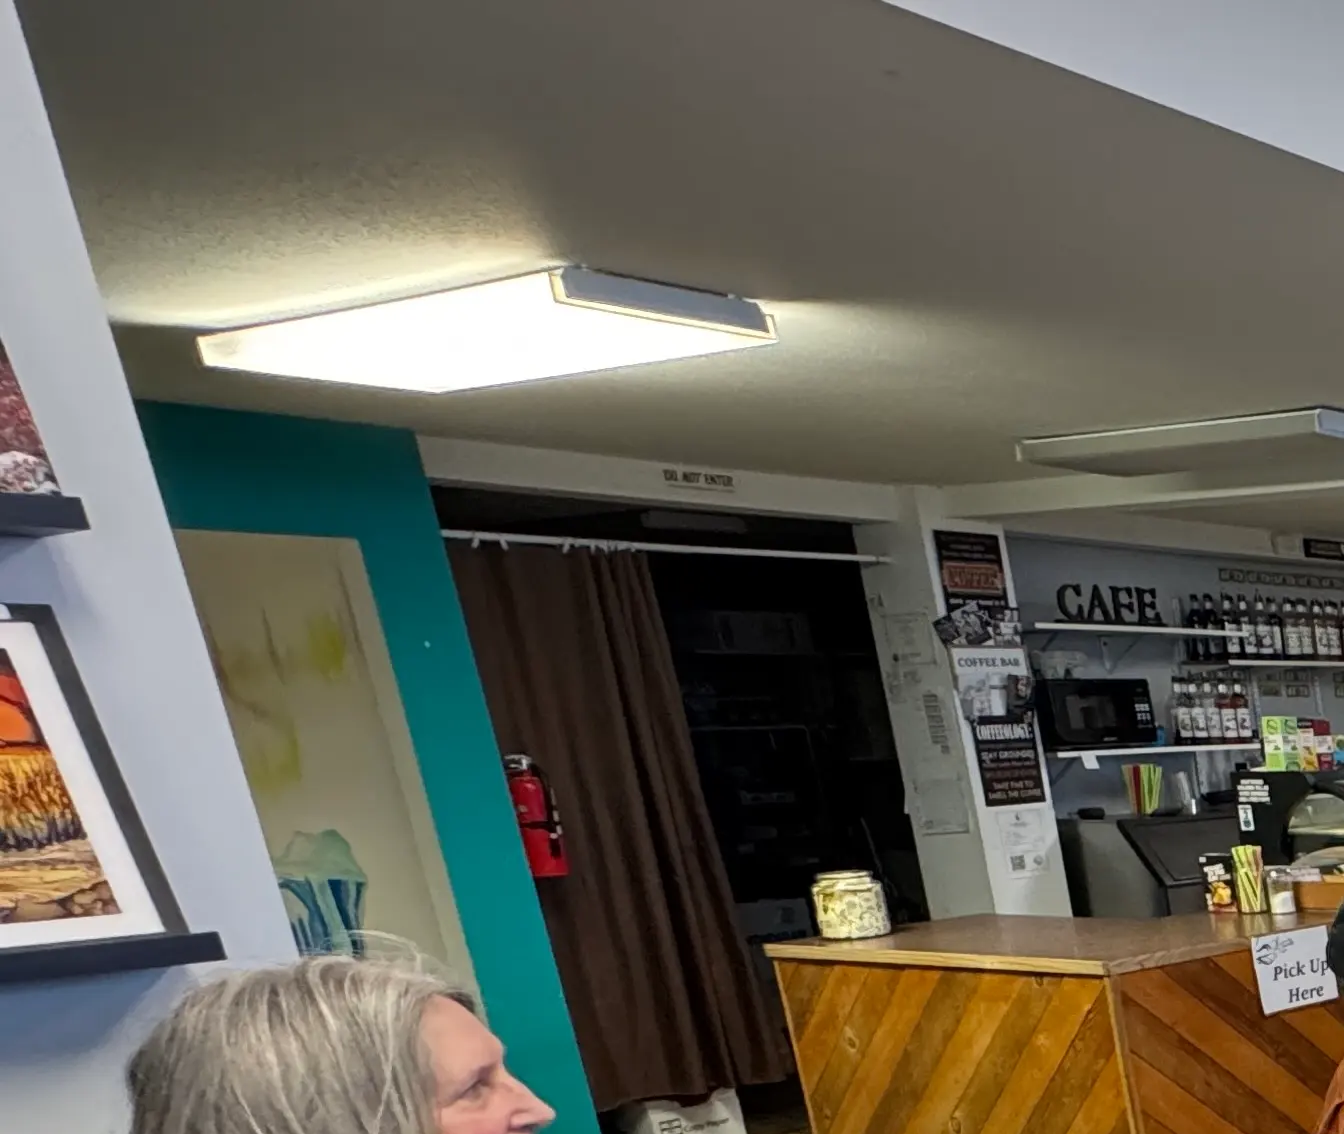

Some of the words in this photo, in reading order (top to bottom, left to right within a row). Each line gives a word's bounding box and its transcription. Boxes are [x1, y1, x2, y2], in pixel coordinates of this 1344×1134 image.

[1057, 584, 1160, 624] CAFE
[957, 657, 998, 668] COFFEE
[1000, 658, 1020, 668] BAR
[1273, 961, 1306, 981] Pick
[1309, 957, 1329, 977] Up
[1288, 985, 1324, 1004] Here
